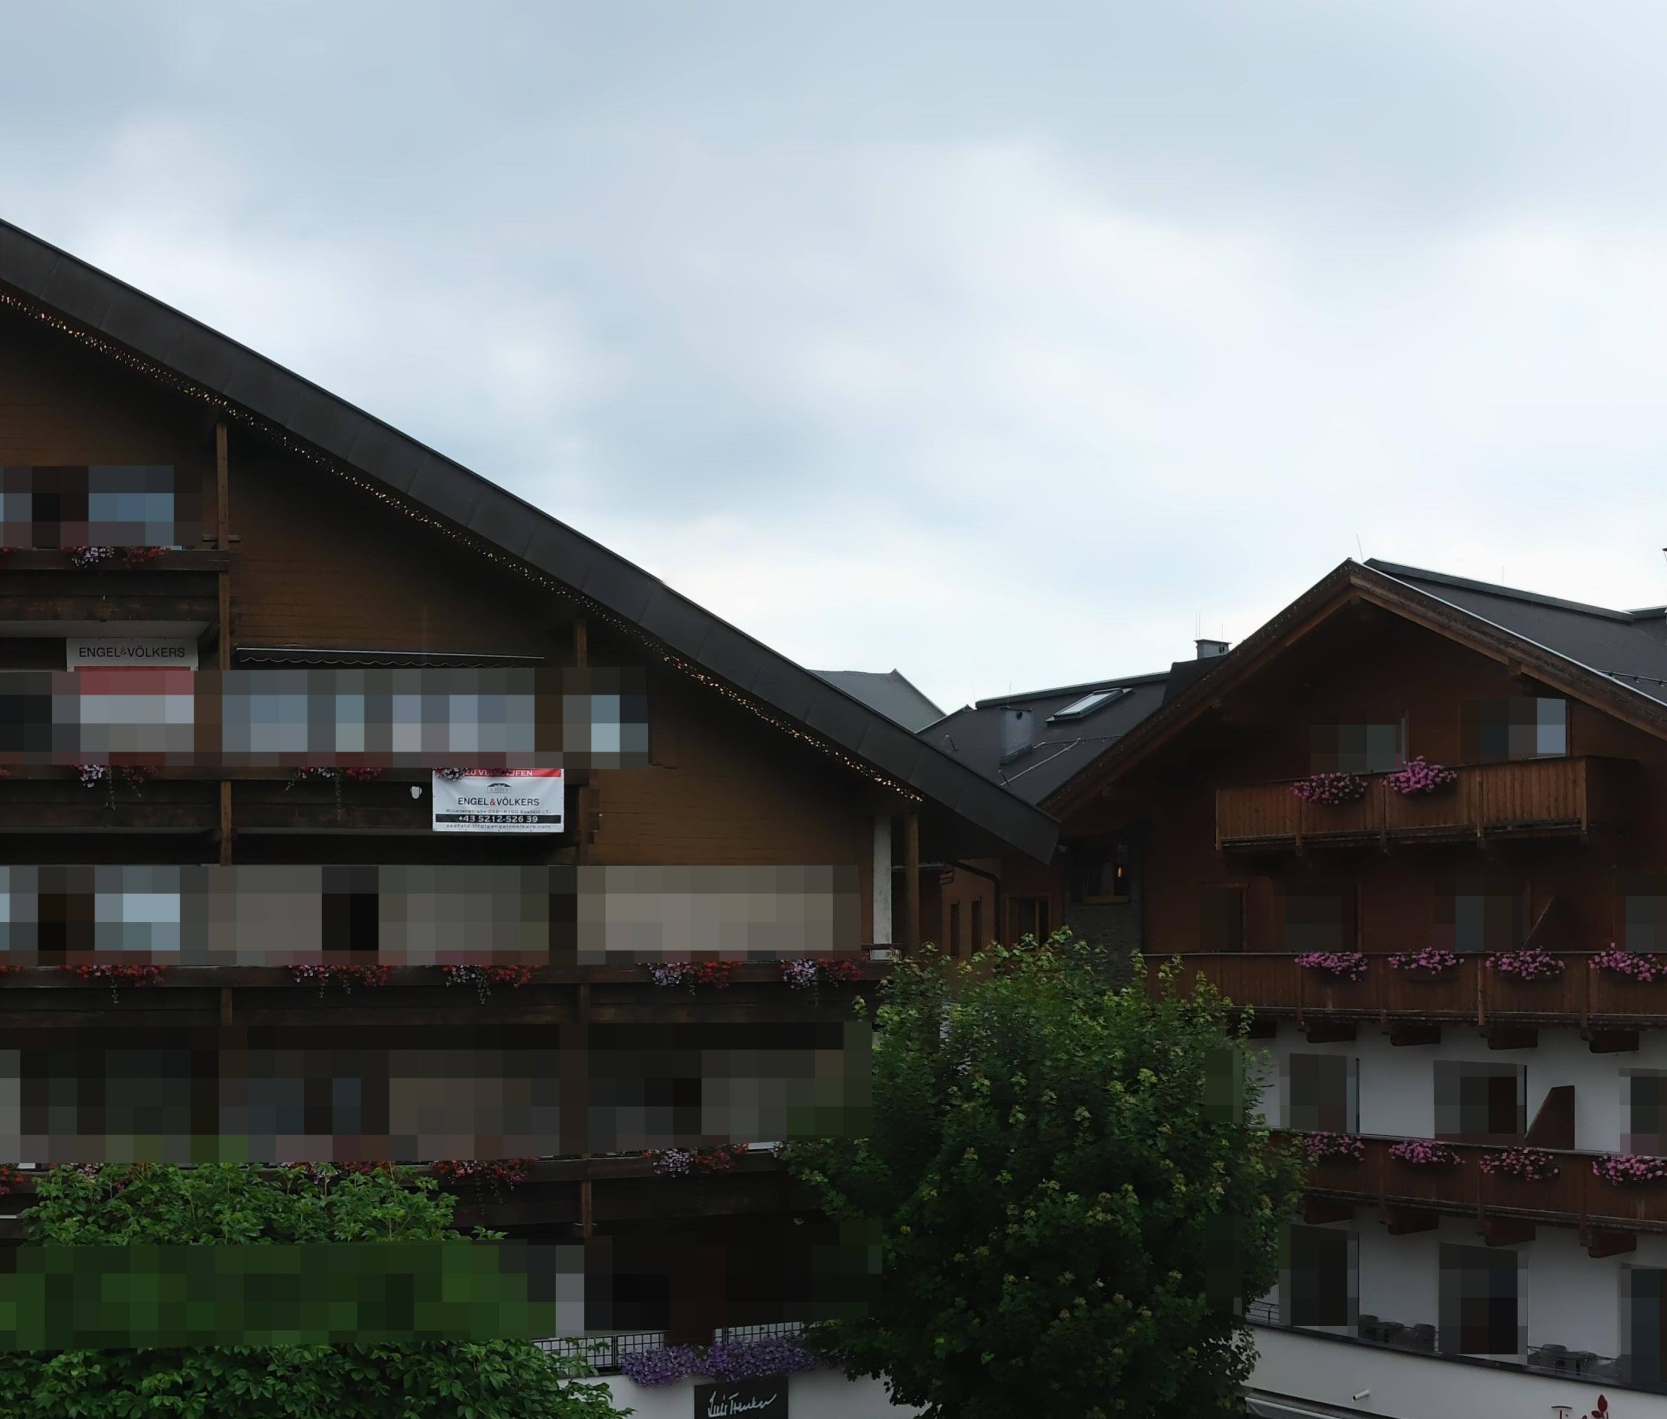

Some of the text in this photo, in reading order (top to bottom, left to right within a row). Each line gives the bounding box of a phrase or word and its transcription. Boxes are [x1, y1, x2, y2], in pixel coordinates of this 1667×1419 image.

[78, 644, 186, 658] ENGEL&VÖLKERS
[457, 796, 540, 807] ENGEL&VÖLKERS
[478, 815, 524, 823] 5212-526
[525, 815, 539, 823] 39
